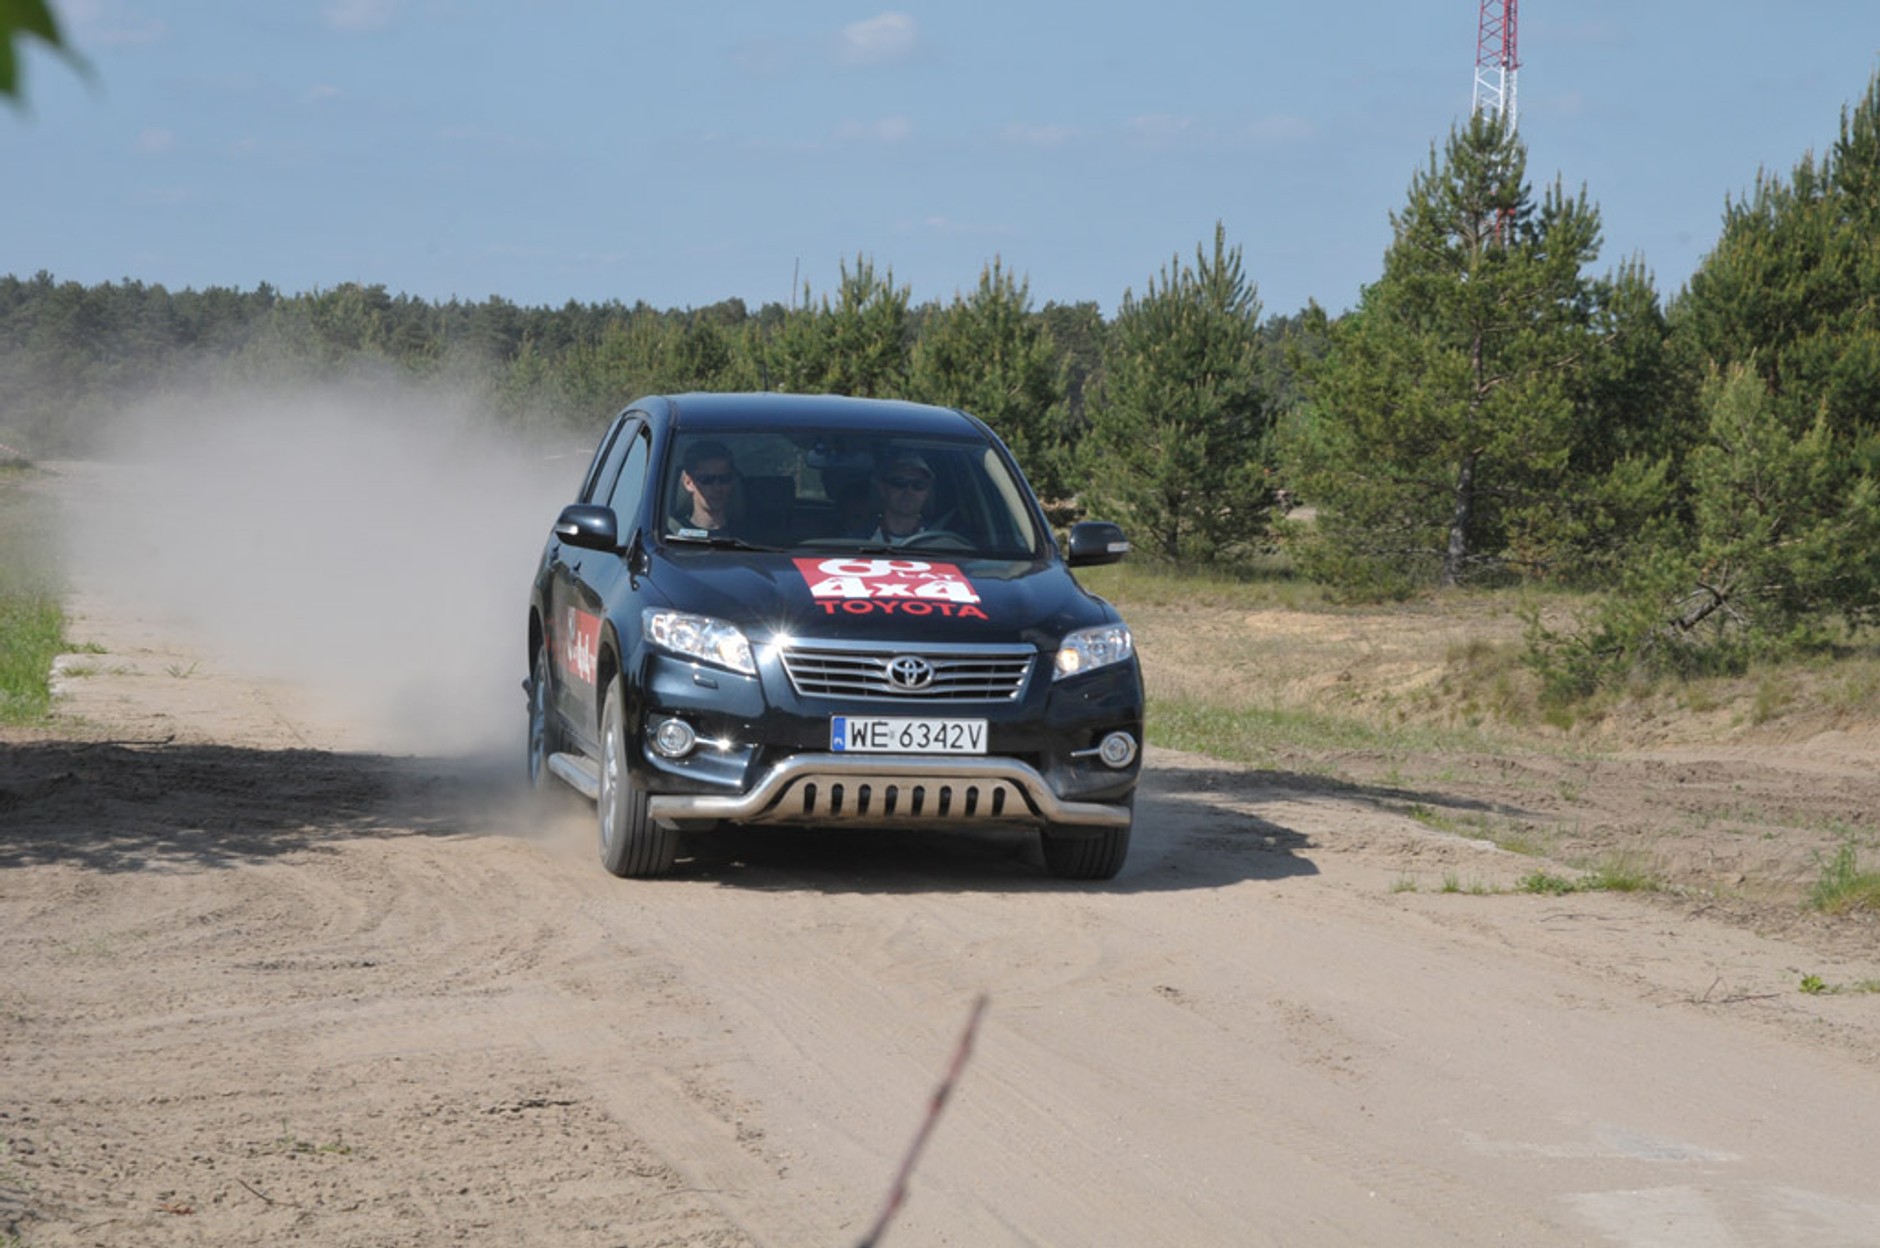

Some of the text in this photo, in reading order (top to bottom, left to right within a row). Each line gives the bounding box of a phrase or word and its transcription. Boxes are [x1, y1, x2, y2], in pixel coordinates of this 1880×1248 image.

[810, 576, 981, 604] 4x4
[815, 600, 989, 620] TOYOTA
[851, 721, 982, 750] WE 6342V
